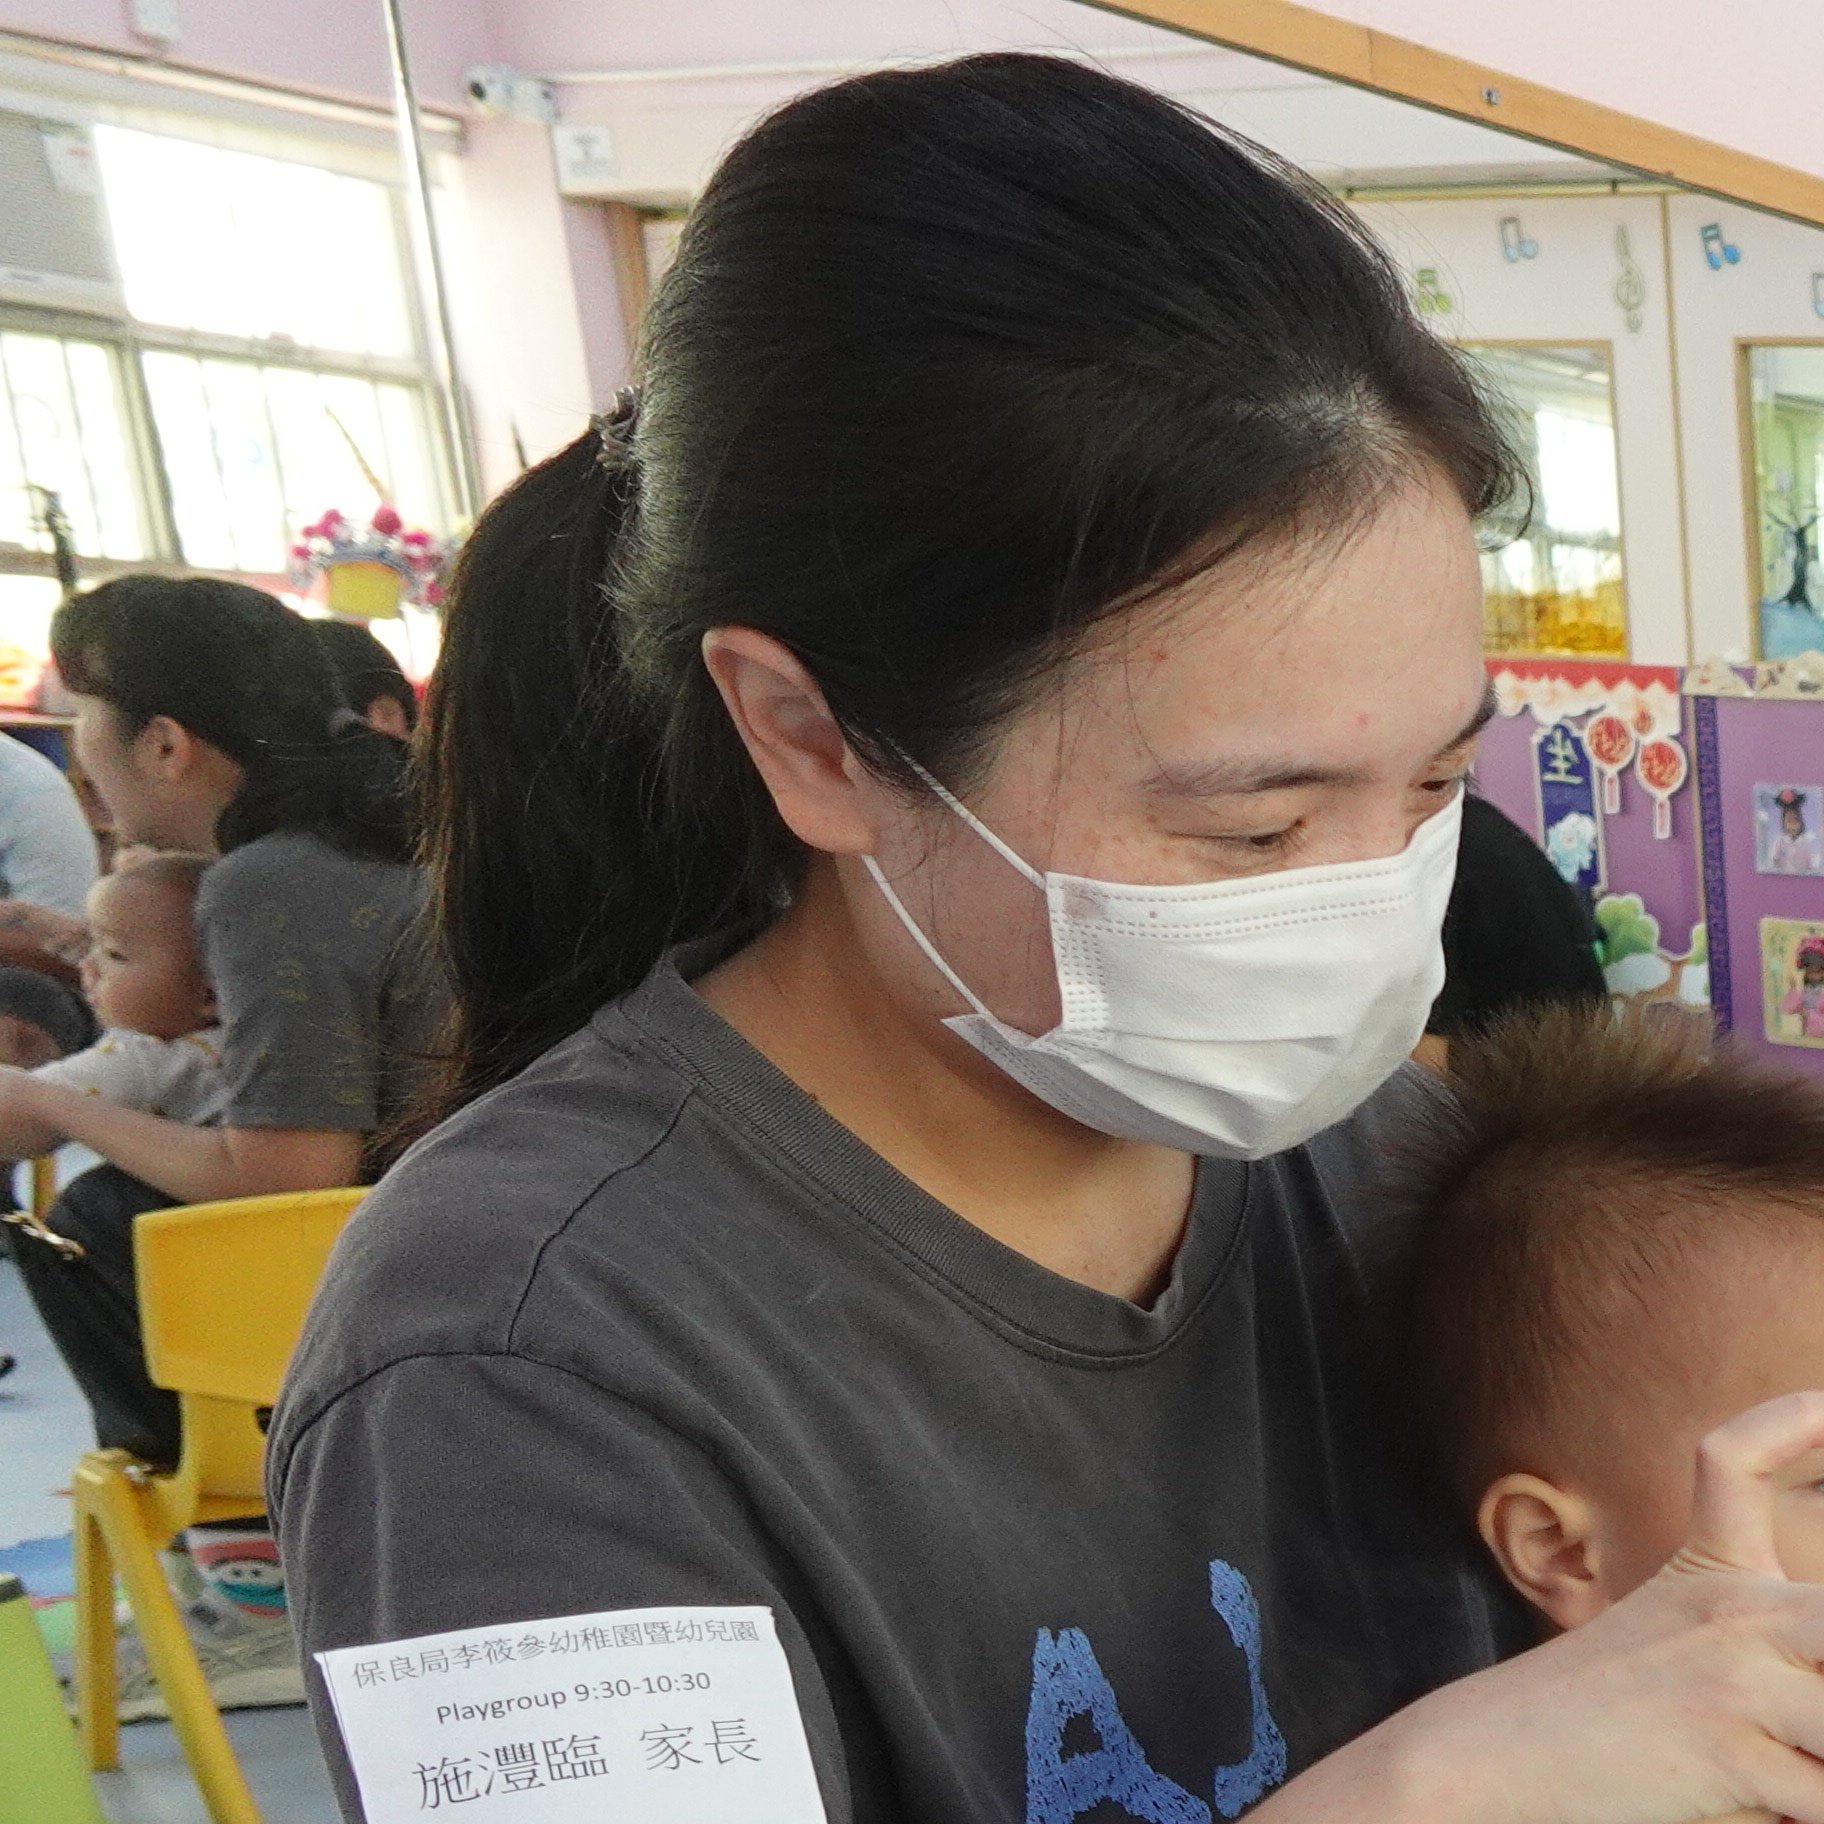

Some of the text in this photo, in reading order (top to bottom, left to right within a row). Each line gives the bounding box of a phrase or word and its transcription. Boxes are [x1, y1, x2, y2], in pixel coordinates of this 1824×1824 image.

[436, 1671, 712, 1725] Playgroup 9:30-10:30
[638, 1717, 763, 1772] 家長
